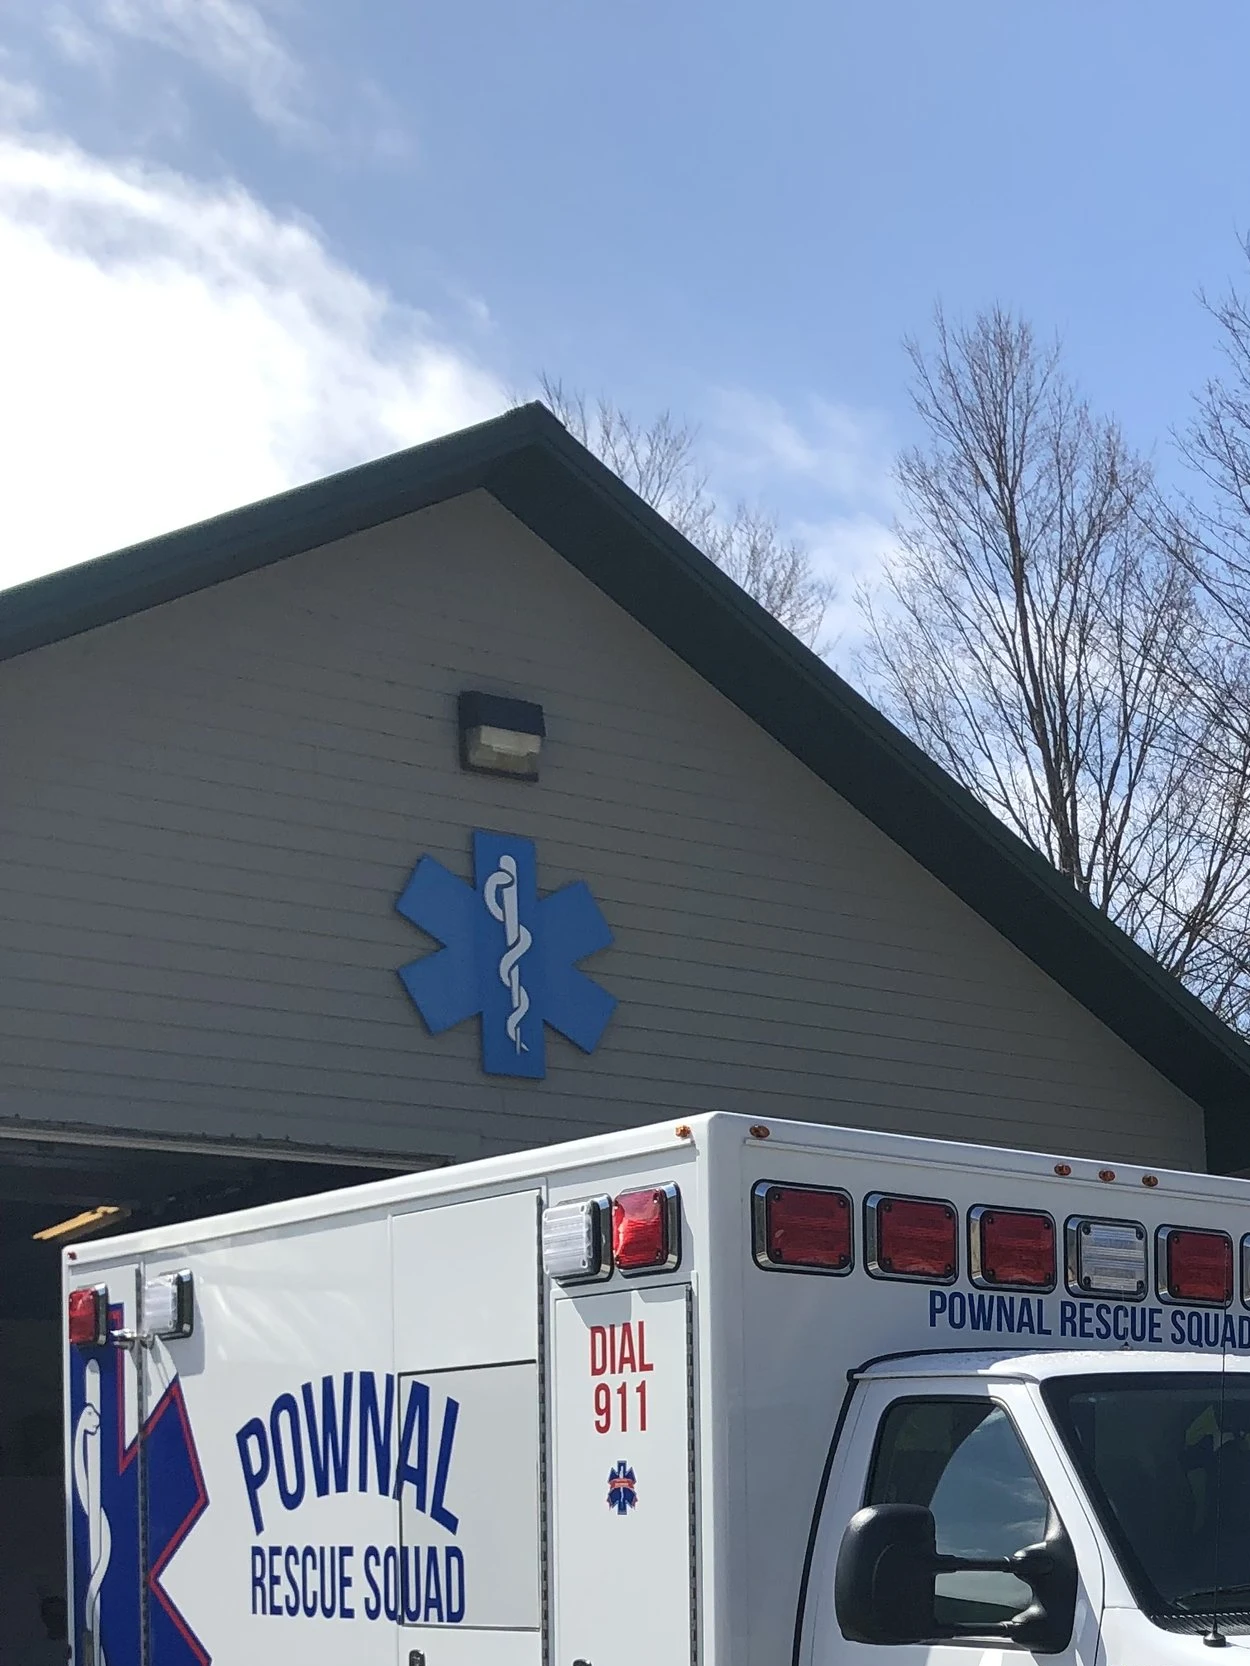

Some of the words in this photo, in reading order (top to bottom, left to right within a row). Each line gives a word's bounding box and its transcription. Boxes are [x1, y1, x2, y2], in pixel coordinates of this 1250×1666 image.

[929, 1290, 1052, 1336] POWNAL
[1060, 1301, 1163, 1344] RESCUE
[590, 1320, 654, 1377] DIAL
[594, 1379, 647, 1434] 911
[235, 1371, 460, 1536] POWNAL
[251, 1545, 355, 1619] RESCUE
[364, 1545, 466, 1624] SQUAD
